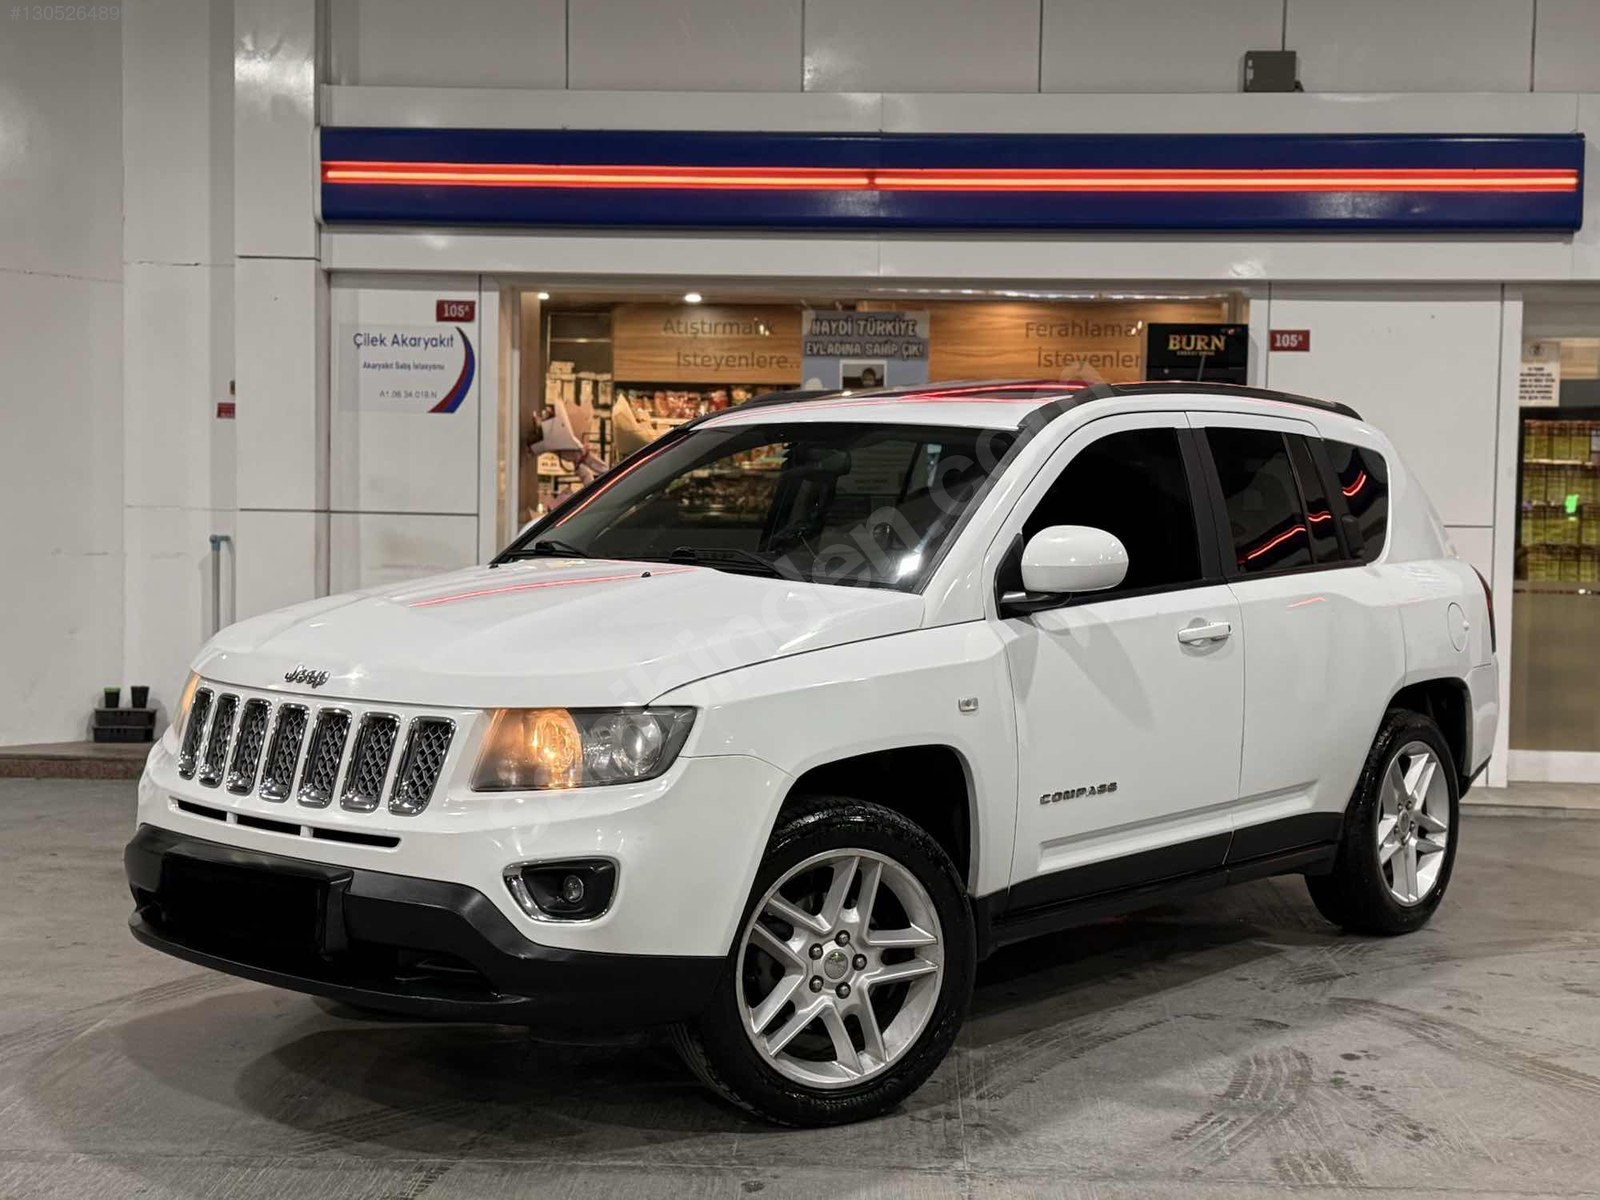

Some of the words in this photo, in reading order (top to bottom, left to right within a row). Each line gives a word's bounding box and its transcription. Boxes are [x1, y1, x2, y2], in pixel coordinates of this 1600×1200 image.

[663, 319, 776, 339] Atıştırmalk
[811, 316, 854, 336] HAYDİ
[857, 316, 918, 336] TÜRKİYE
[353, 332, 387, 349] Çilek
[391, 333, 454, 350] Akaryakıt
[1168, 334, 1226, 352] BURN
[285, 664, 331, 689] Jeep
[1040, 782, 1118, 805] COMPASS
